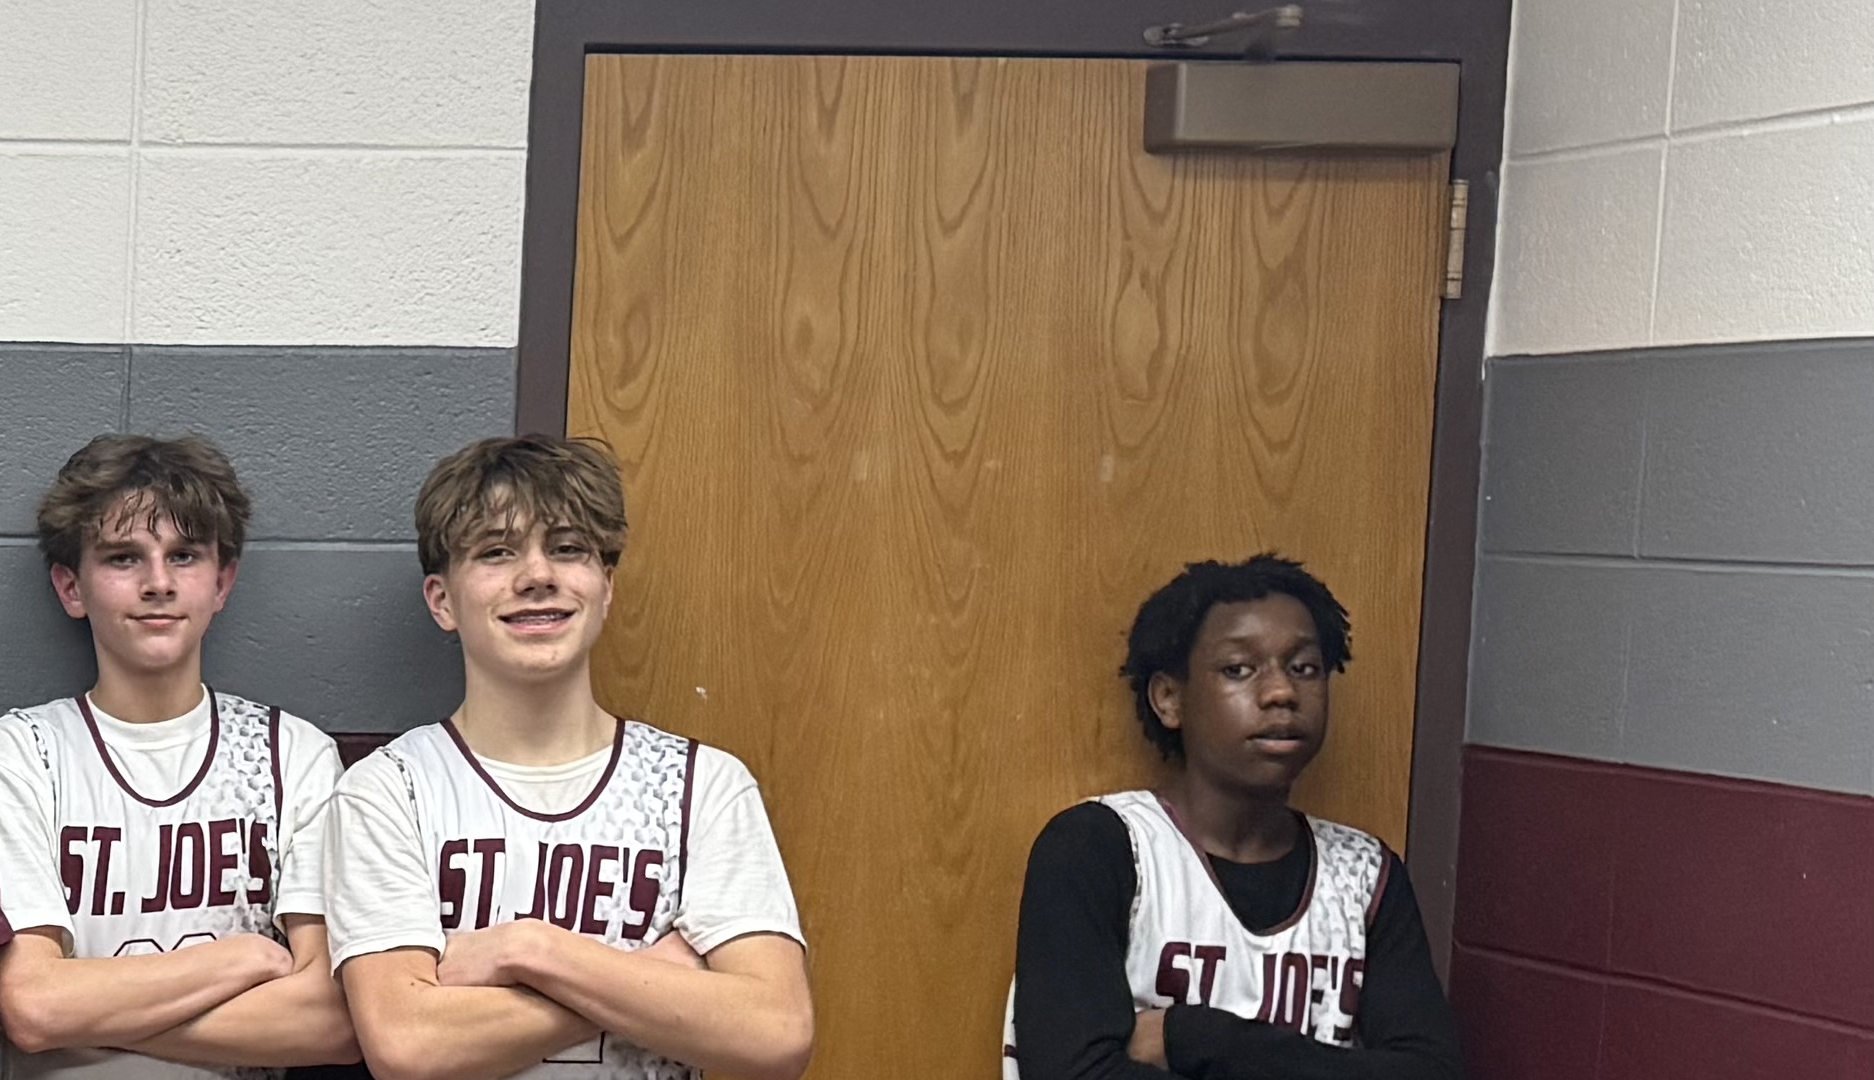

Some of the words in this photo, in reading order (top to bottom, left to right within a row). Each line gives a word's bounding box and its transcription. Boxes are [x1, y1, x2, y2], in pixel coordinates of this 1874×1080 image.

[60, 825, 126, 916] ST.
[140, 818, 272, 914] JOE'S
[440, 838, 505, 930] ST
[514, 841, 664, 940] JOE'S
[1155, 941, 1227, 1008] ST
[1256, 952, 1365, 1042] JOE'S
